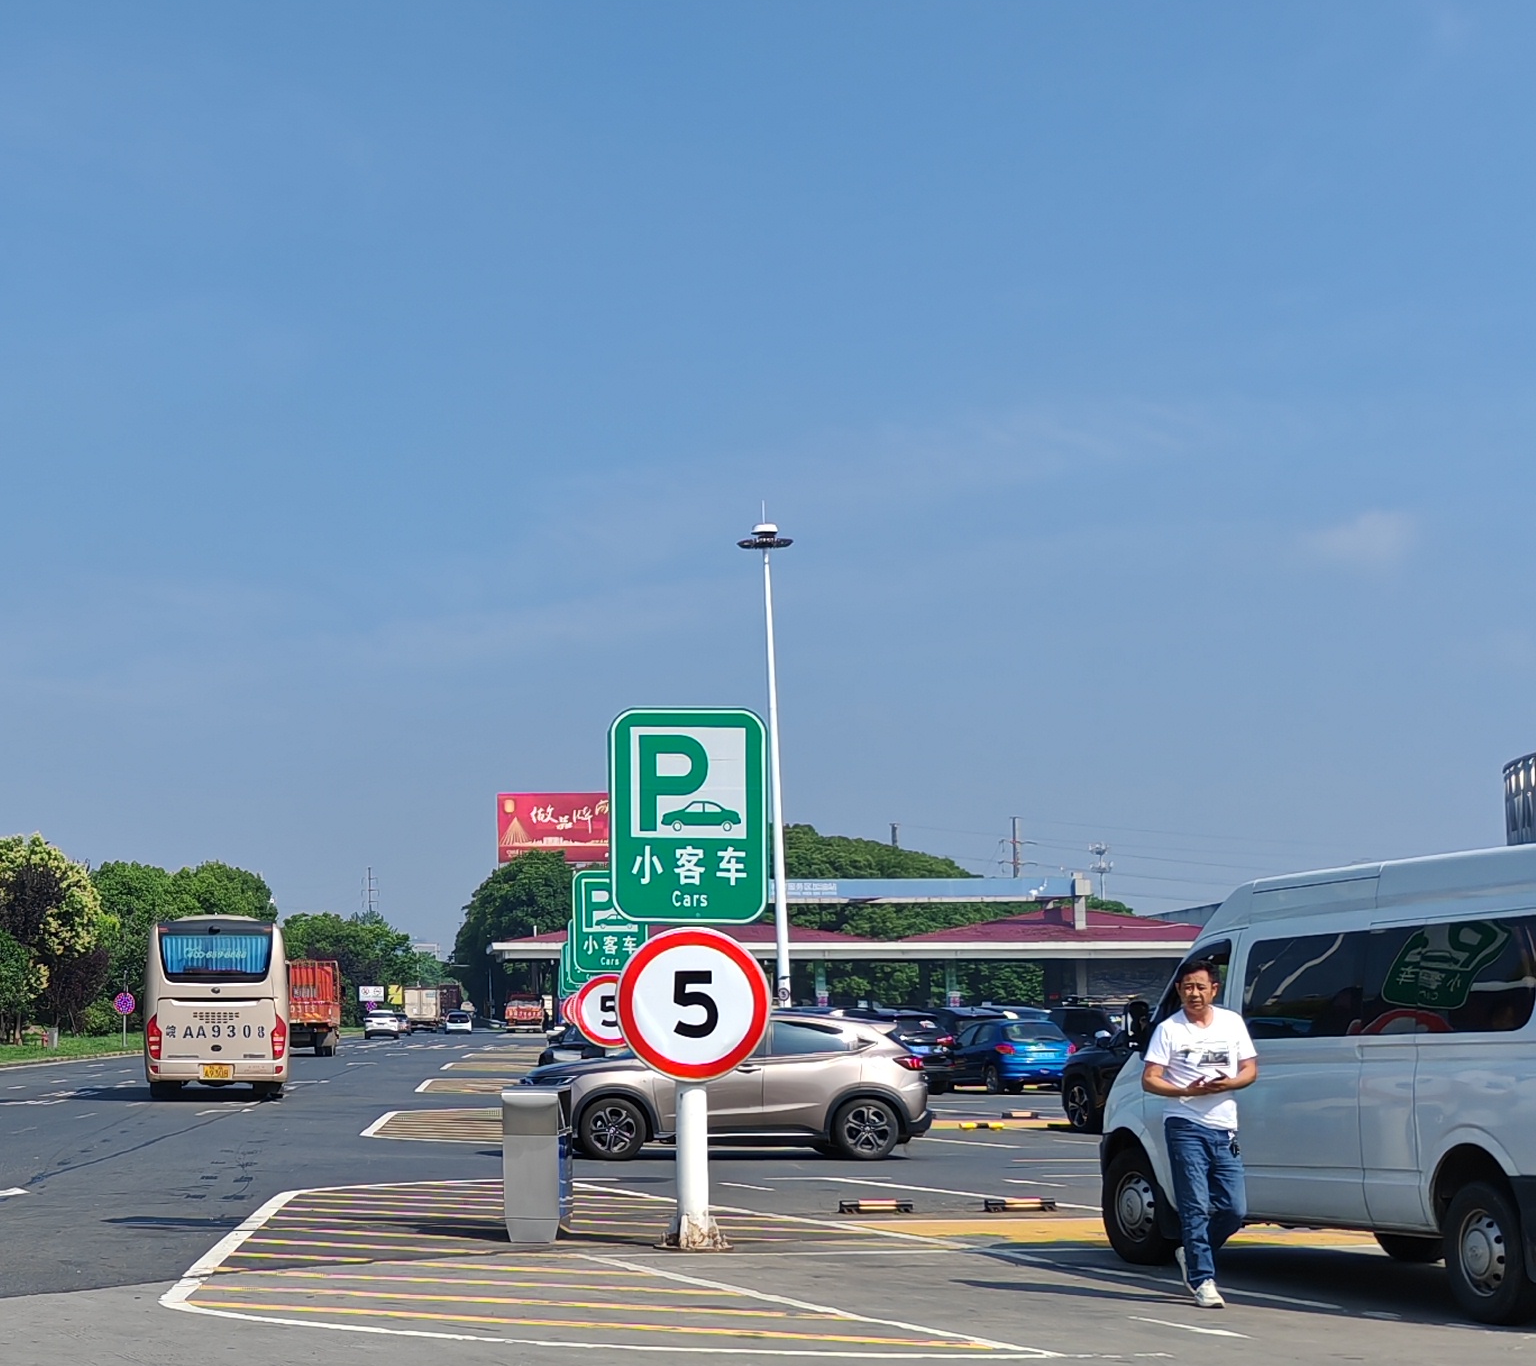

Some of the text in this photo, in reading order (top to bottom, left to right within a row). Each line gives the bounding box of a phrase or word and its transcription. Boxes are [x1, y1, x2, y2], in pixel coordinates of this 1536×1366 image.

[639, 735, 708, 831] P
[631, 845, 747, 886] 小客车
[672, 891, 708, 907] Cars
[583, 936, 638, 955] 小客车
[600, 956, 620, 966] Cars
[674, 970, 719, 1038] 5
